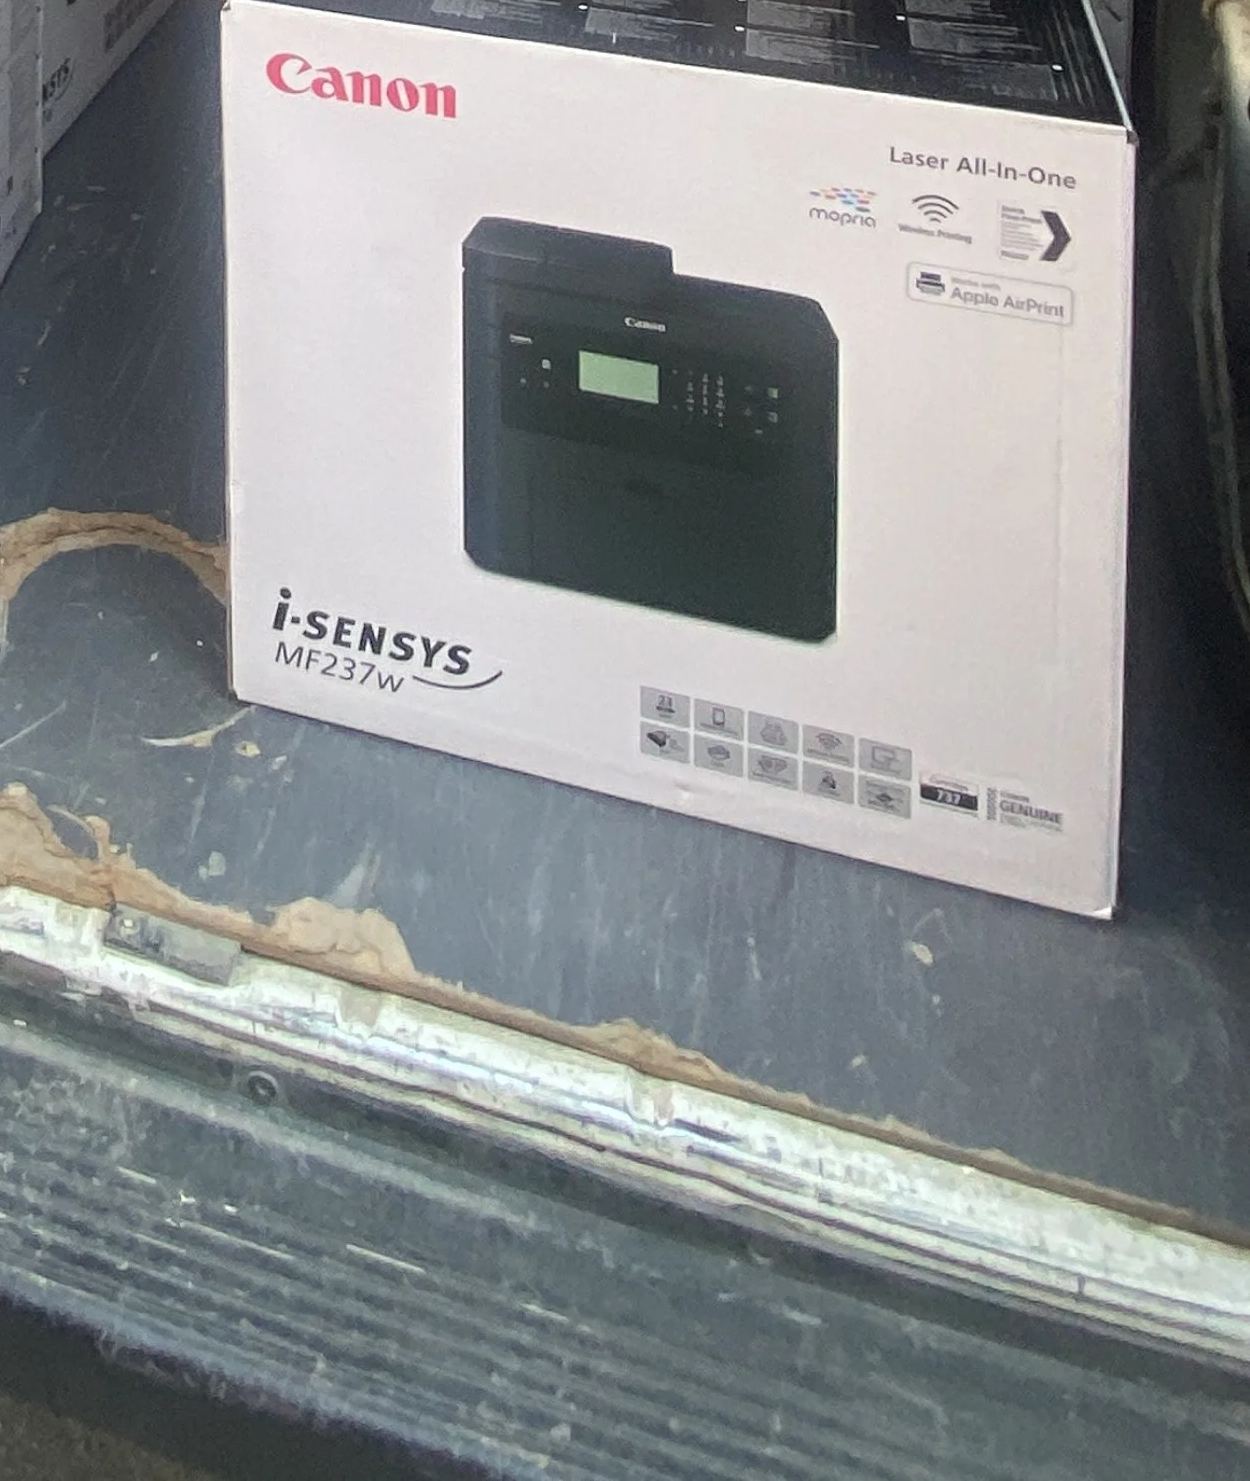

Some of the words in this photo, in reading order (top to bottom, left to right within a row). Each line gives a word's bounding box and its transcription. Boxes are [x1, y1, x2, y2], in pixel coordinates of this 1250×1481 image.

[266, 52, 458, 119] Canon
[889, 145, 950, 170] Laser
[956, 157, 1078, 190] All-In-One
[808, 206, 877, 229] mopria
[950, 286, 1000, 308] Apple
[1002, 295, 1065, 318] AirPrint
[271, 587, 474, 675] i-SENSYS
[274, 641, 405, 693] MF237w
[1000, 800, 1063, 824] GENUINE
